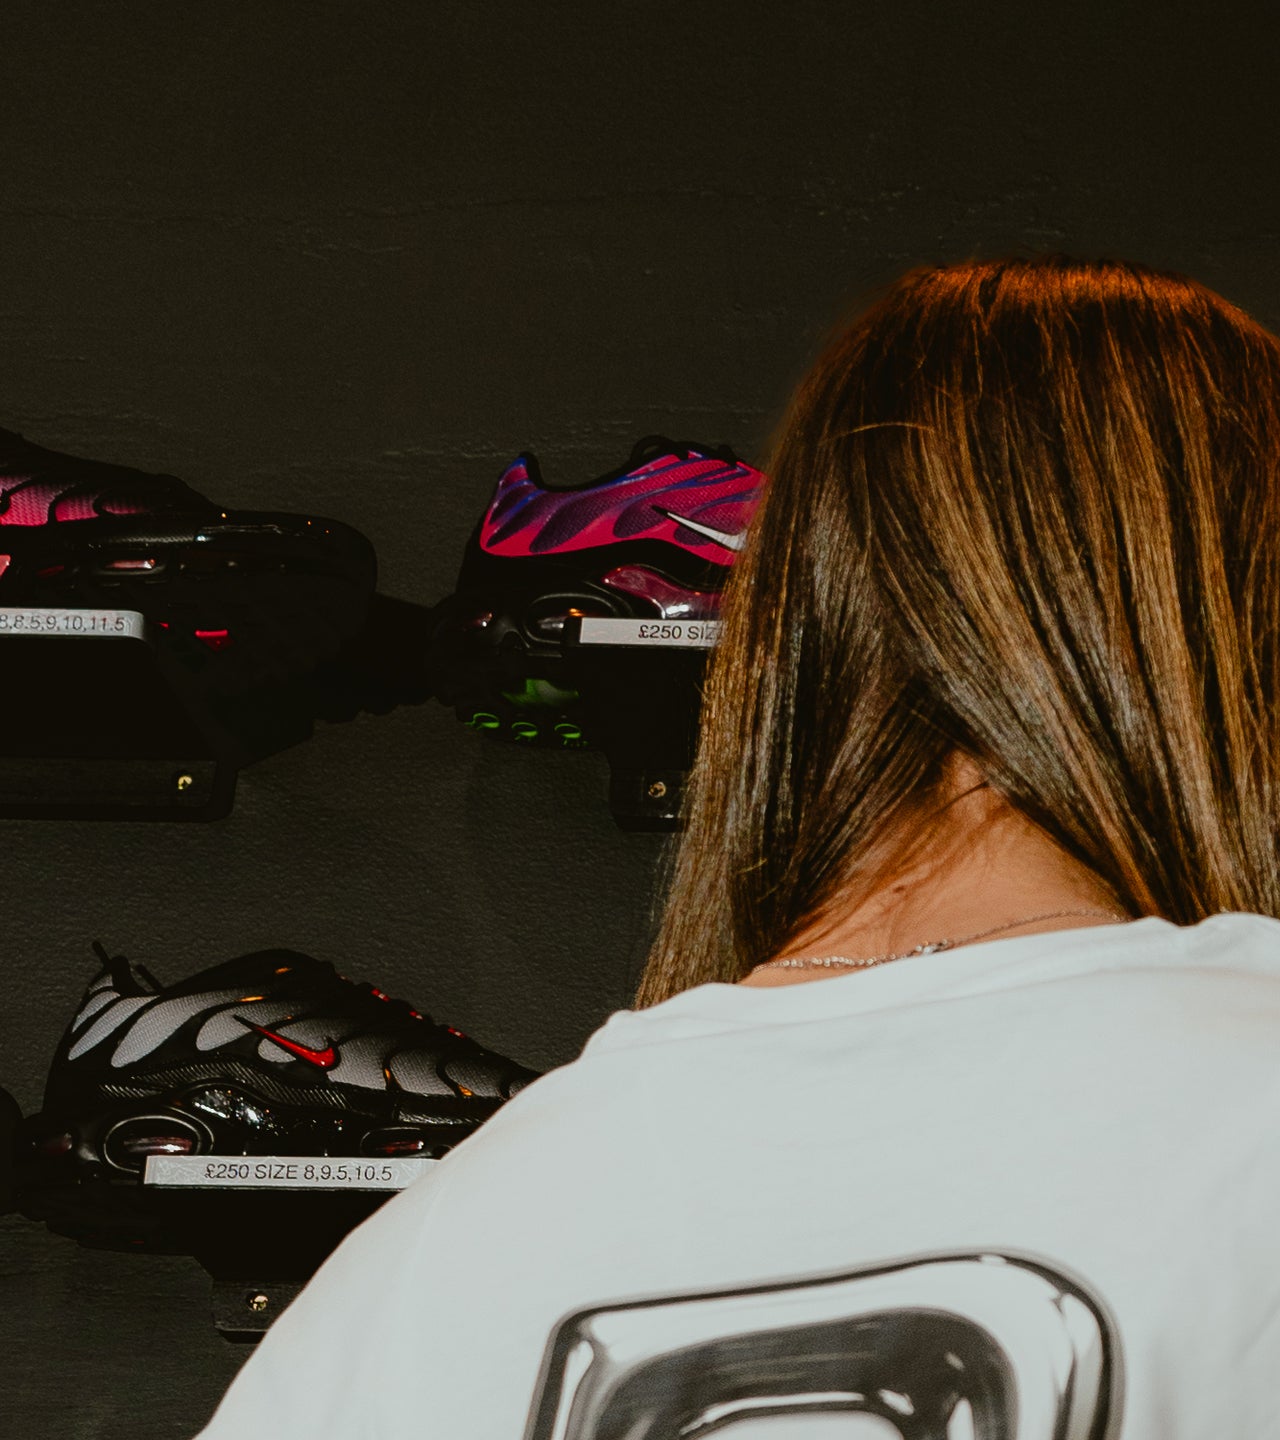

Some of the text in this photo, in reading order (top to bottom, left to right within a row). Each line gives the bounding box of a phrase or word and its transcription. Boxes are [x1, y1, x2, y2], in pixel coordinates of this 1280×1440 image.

[638, 624, 717, 640] £250 SIZ
[204, 1163, 392, 1182] £250 SIZE 8,9.5,10.5
